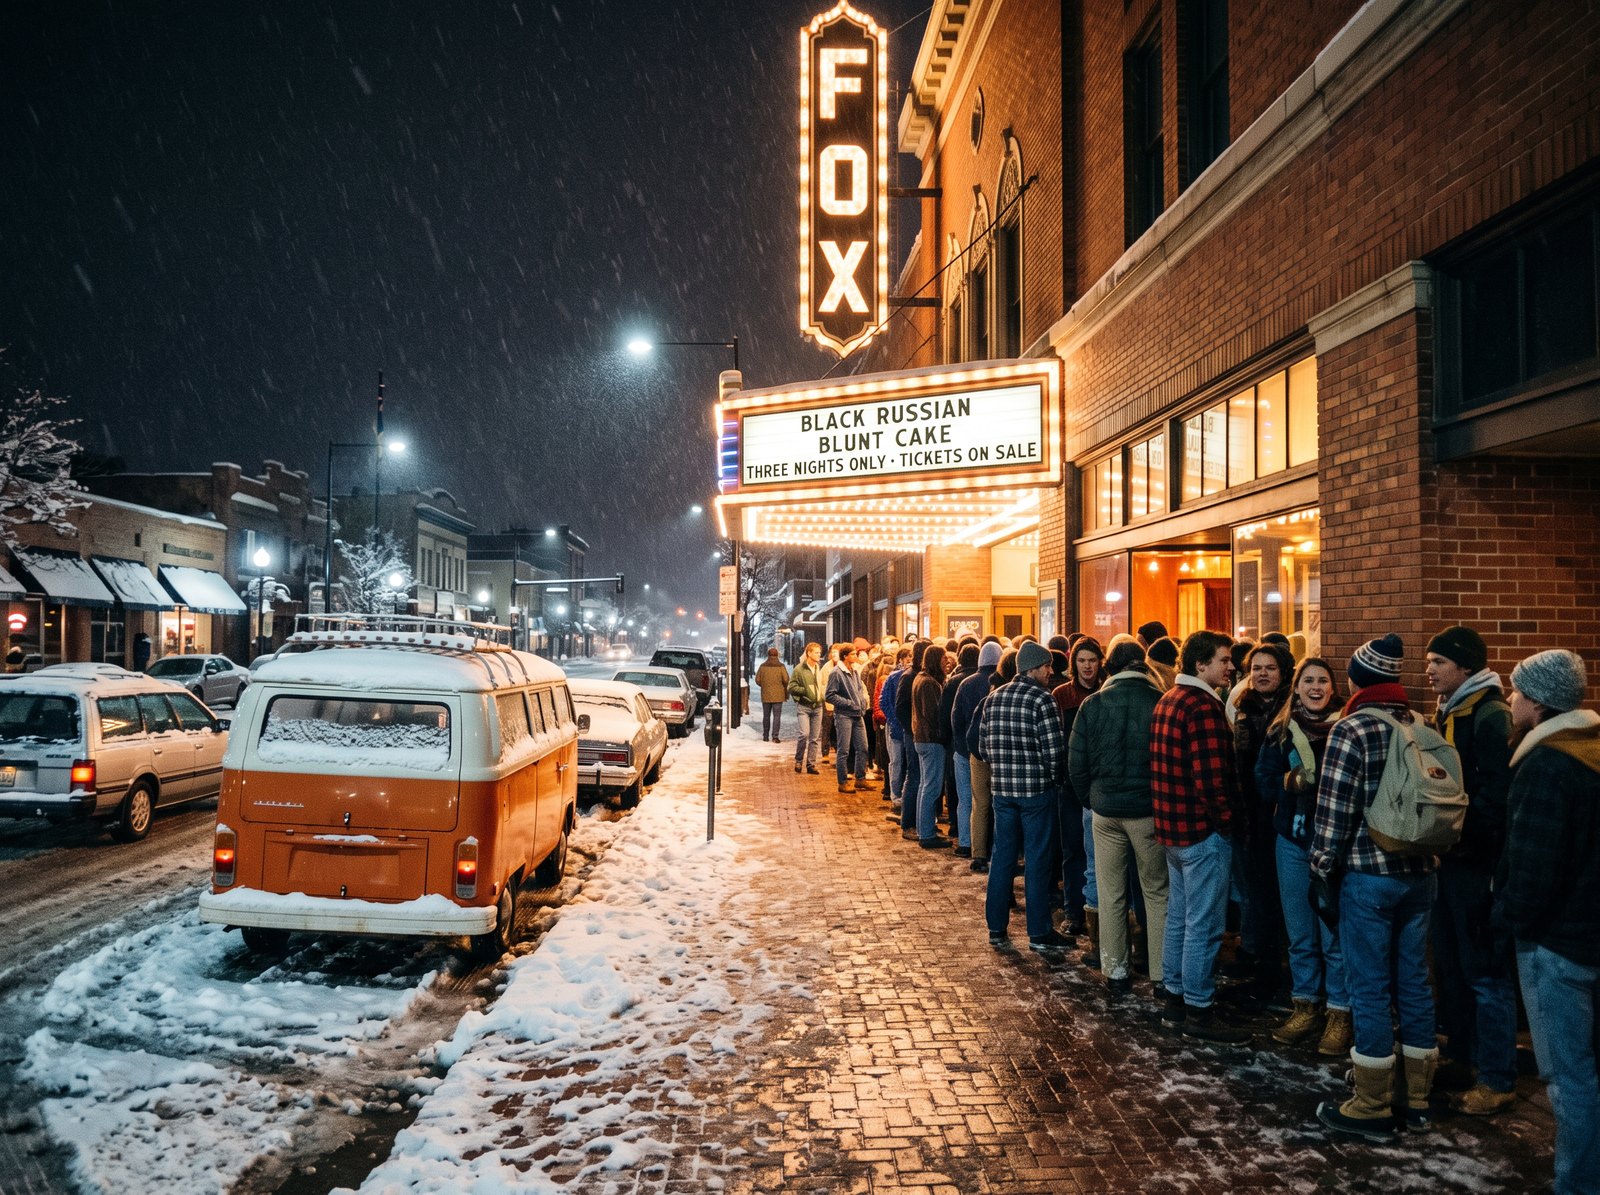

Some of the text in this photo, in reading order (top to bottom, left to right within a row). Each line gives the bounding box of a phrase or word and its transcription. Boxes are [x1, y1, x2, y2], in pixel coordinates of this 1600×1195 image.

[818, 47, 870, 313] FOX
[801, 397, 971, 433] BLACK RUSSIAN
[819, 424, 952, 454] BLUNT CAKE
[747, 441, 1037, 479] THREE NIGHTS ONLY TICKETS ON SALE
